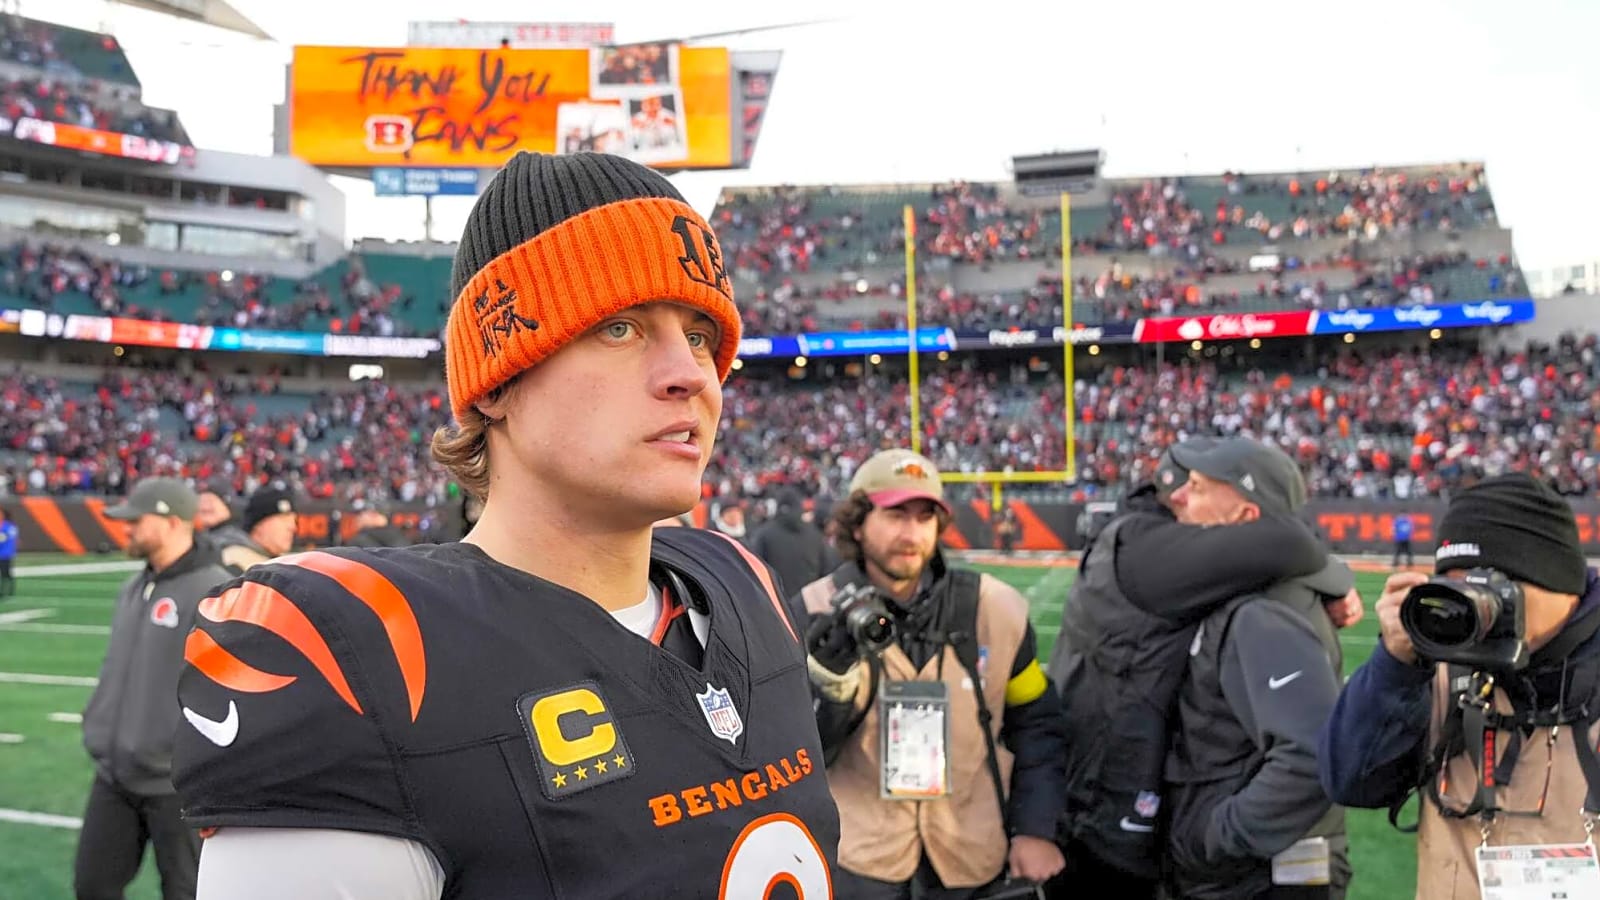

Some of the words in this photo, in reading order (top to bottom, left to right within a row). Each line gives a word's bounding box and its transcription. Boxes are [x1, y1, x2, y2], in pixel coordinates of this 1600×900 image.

[531, 688, 617, 767] C
[710, 709, 738, 733] NFL
[648, 748, 813, 828] BENGALS
